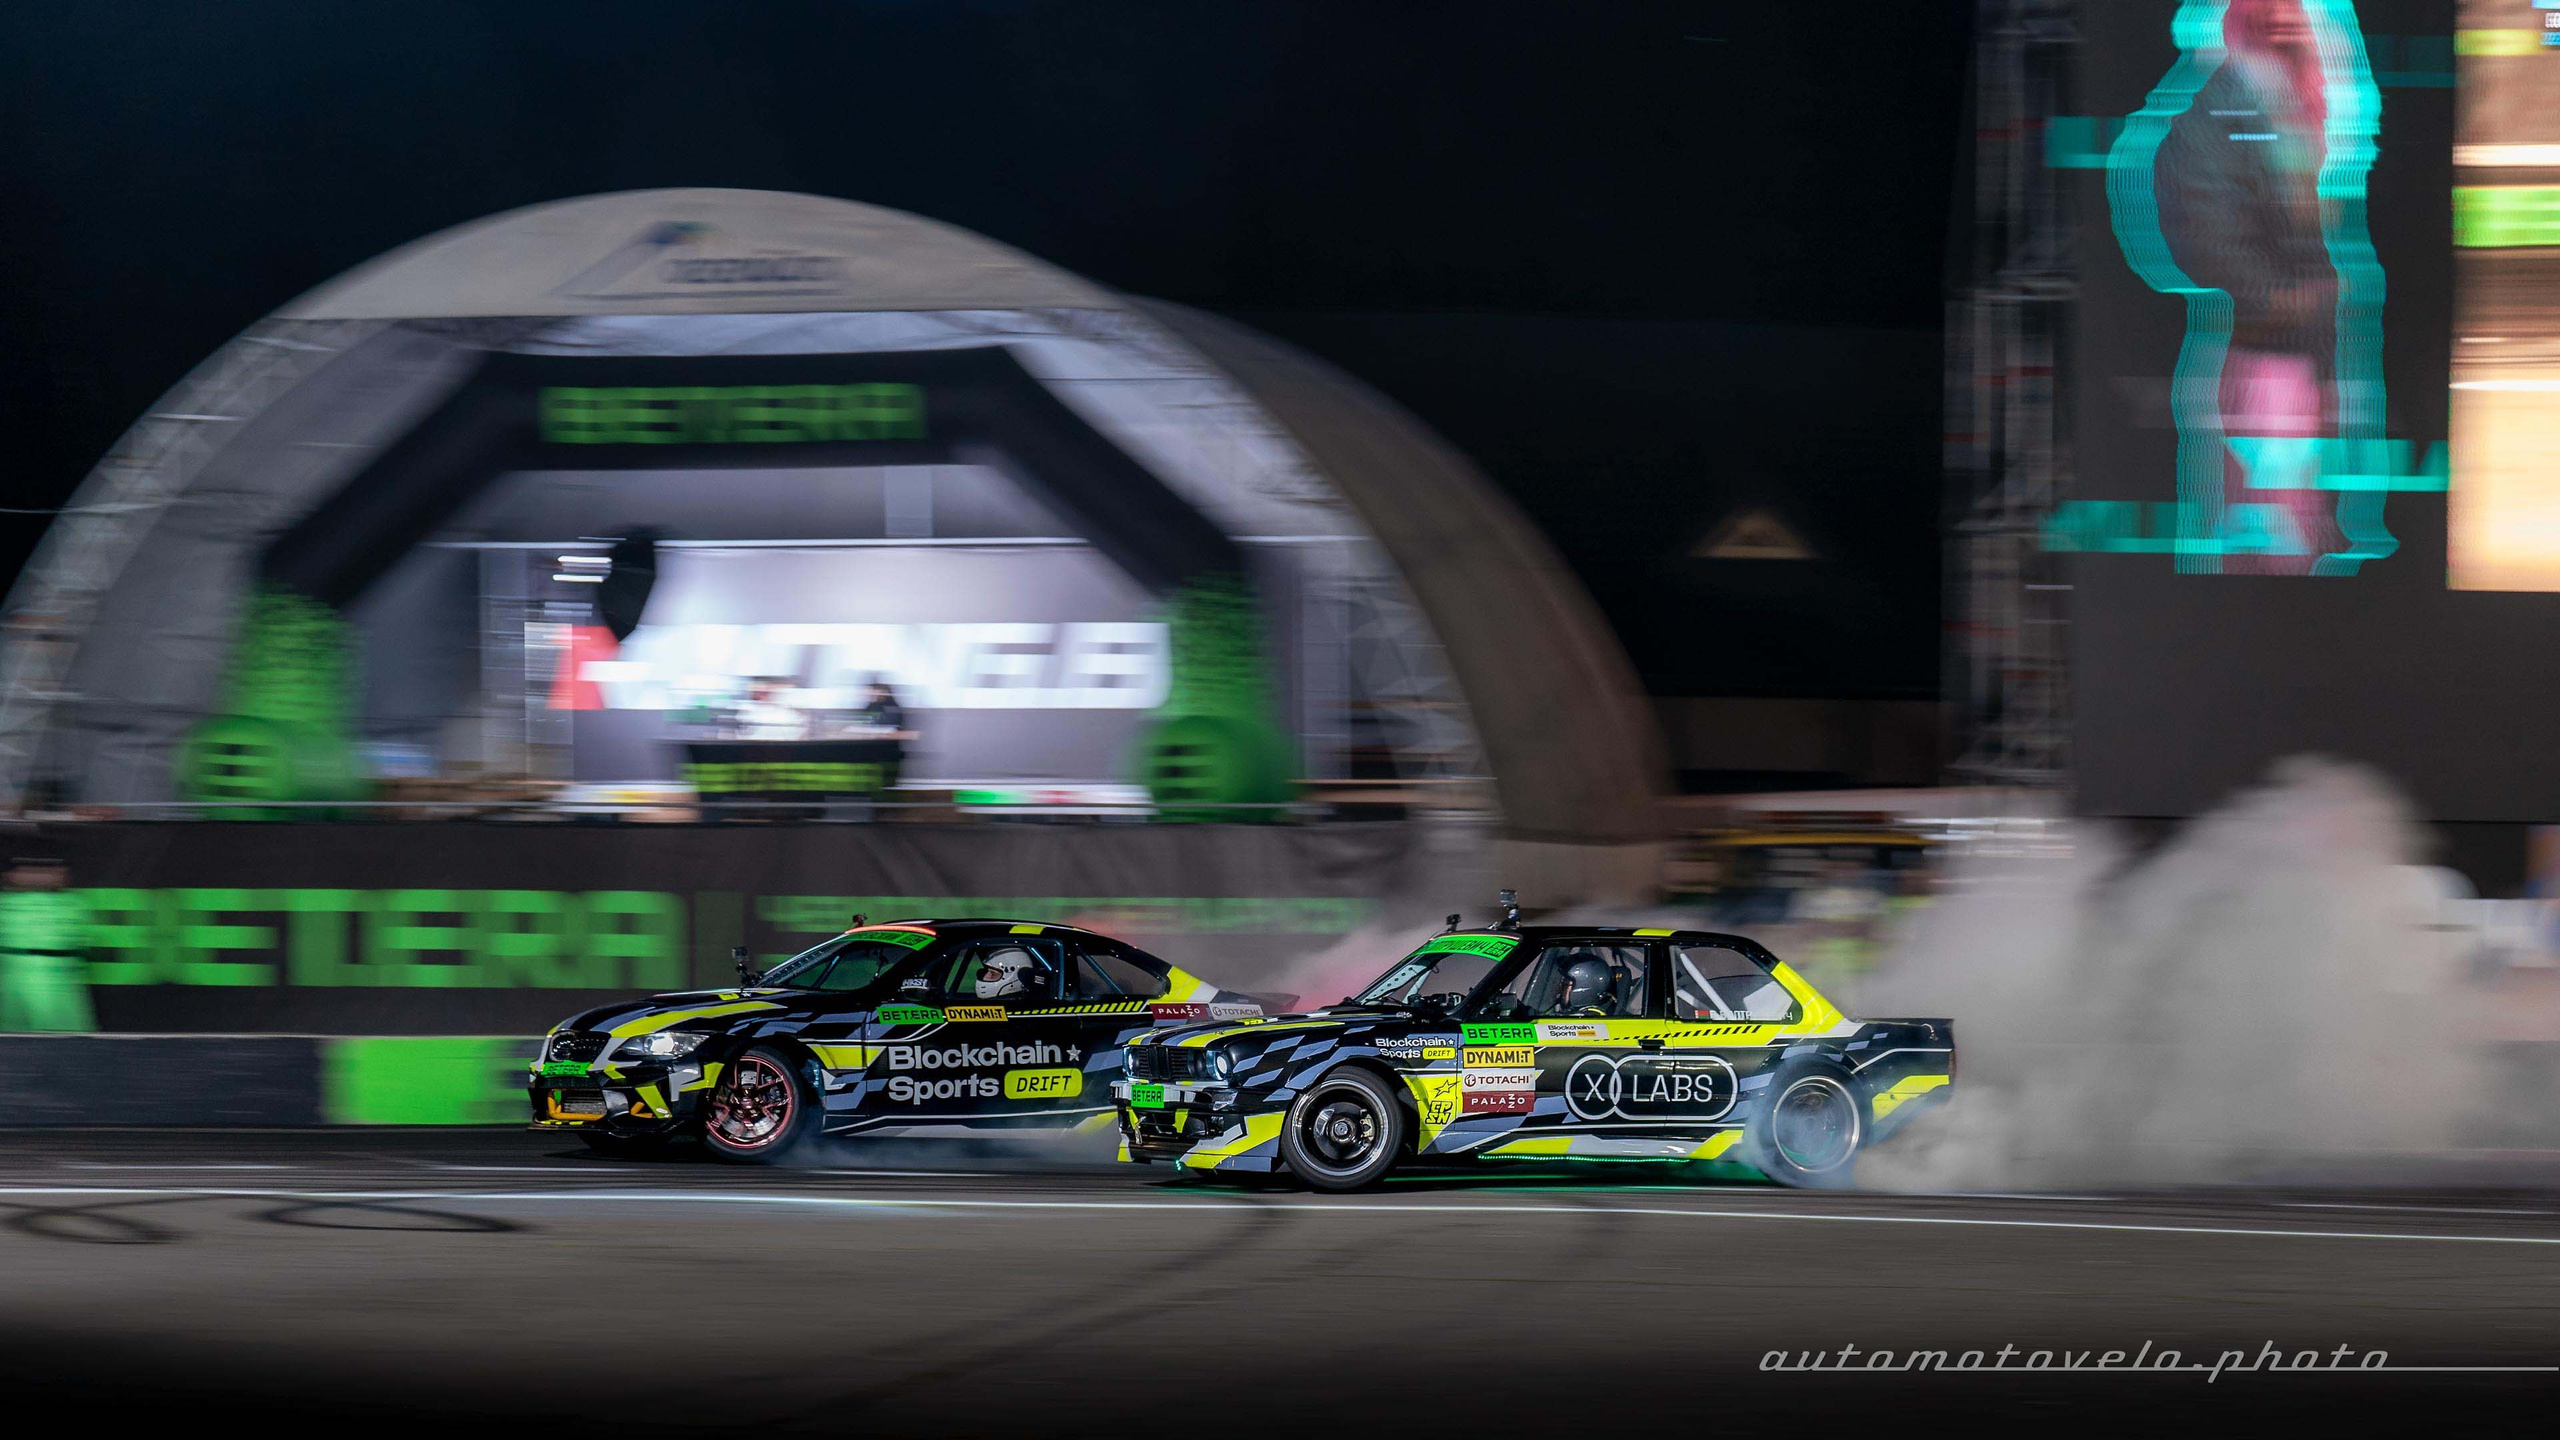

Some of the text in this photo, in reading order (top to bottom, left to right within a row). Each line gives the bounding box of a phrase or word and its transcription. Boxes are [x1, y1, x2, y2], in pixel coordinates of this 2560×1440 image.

[1222, 1008, 1260, 1016] TOTACHI
[1374, 1036, 1447, 1048] Blockchain
[888, 1040, 1062, 1070] Blockchain
[1379, 1048, 1421, 1059] Sports
[1478, 1076, 1530, 1084] TOTACHI
[888, 1073, 1072, 1105] Sports DRIFT
[1632, 1073, 1713, 1102] LABS
